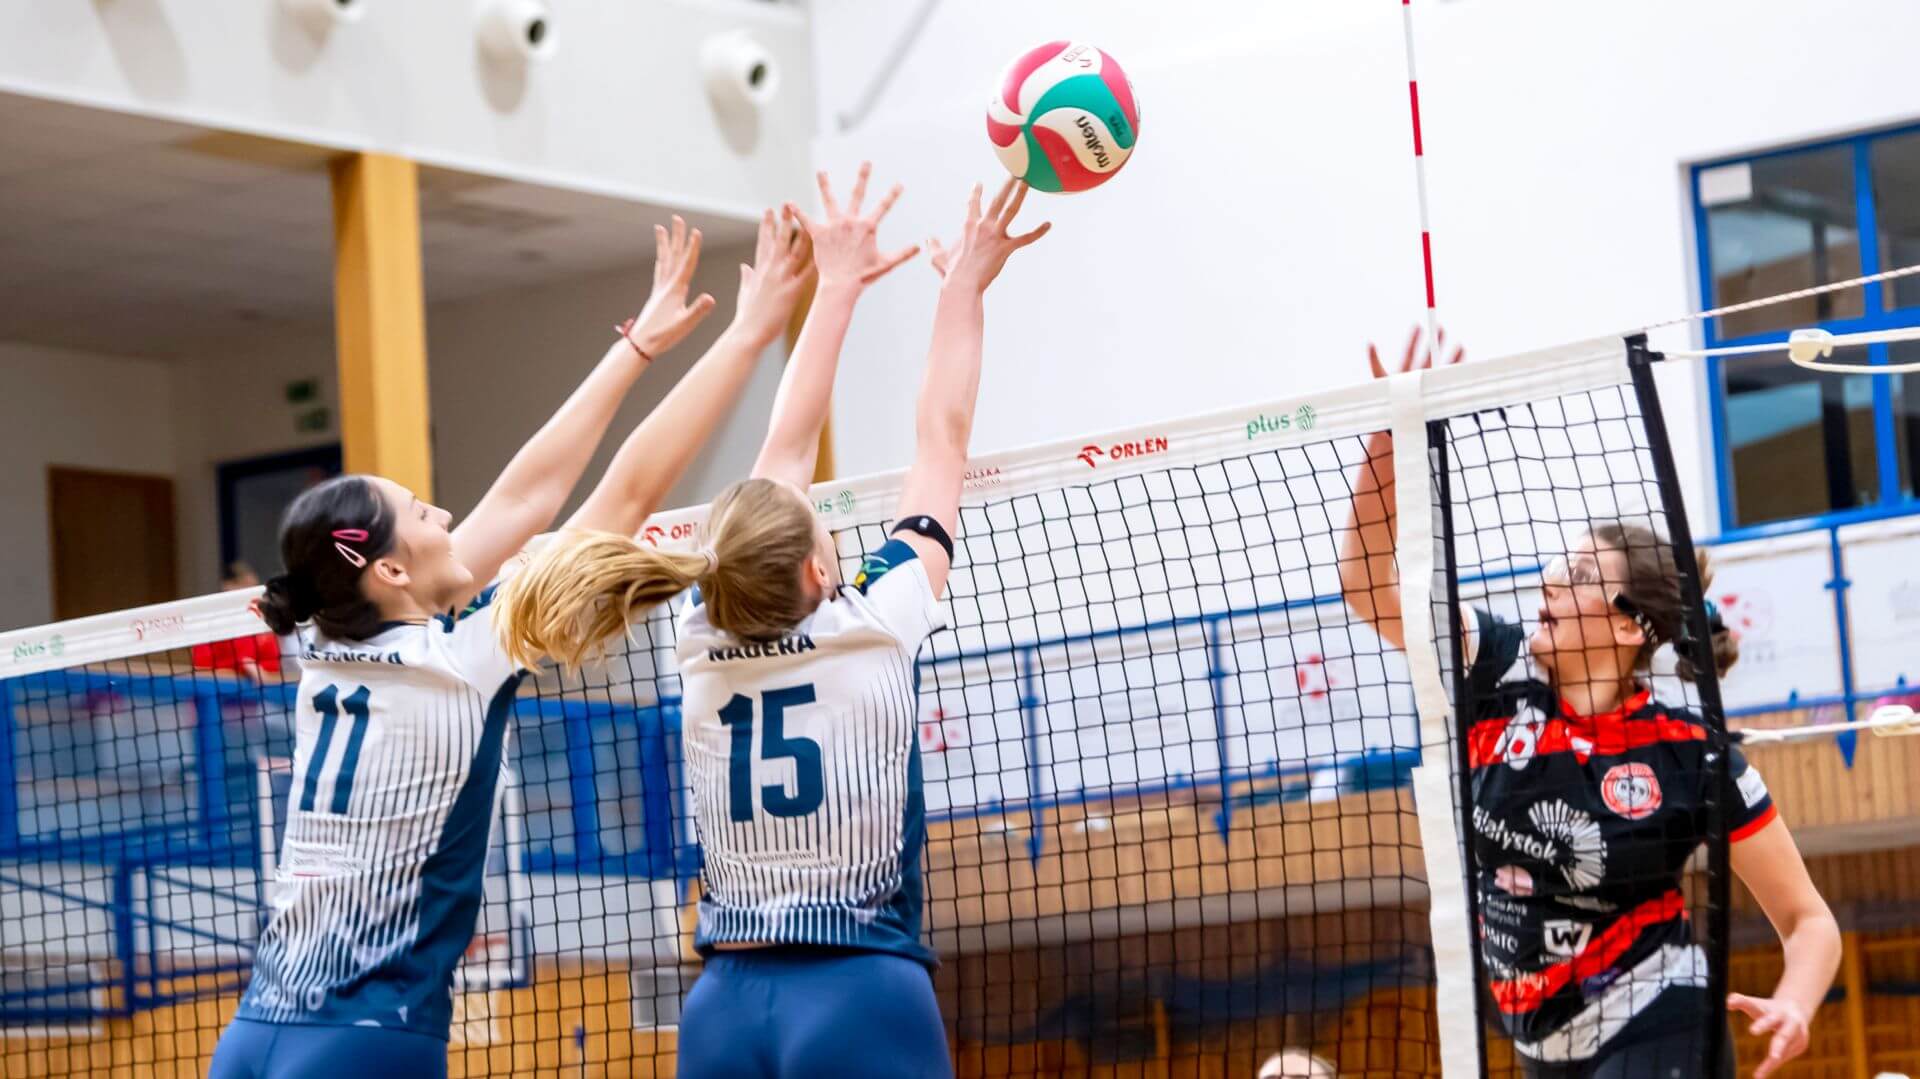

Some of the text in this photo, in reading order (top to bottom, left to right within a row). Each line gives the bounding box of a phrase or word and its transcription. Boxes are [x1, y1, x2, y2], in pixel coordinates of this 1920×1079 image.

[1074, 115, 1111, 168] molten
[1246, 413, 1290, 440] plus
[1110, 437, 1168, 460] ORLEN
[963, 467, 1001, 480] OLSKA
[299, 684, 371, 814] 11
[717, 683, 824, 823] 15
